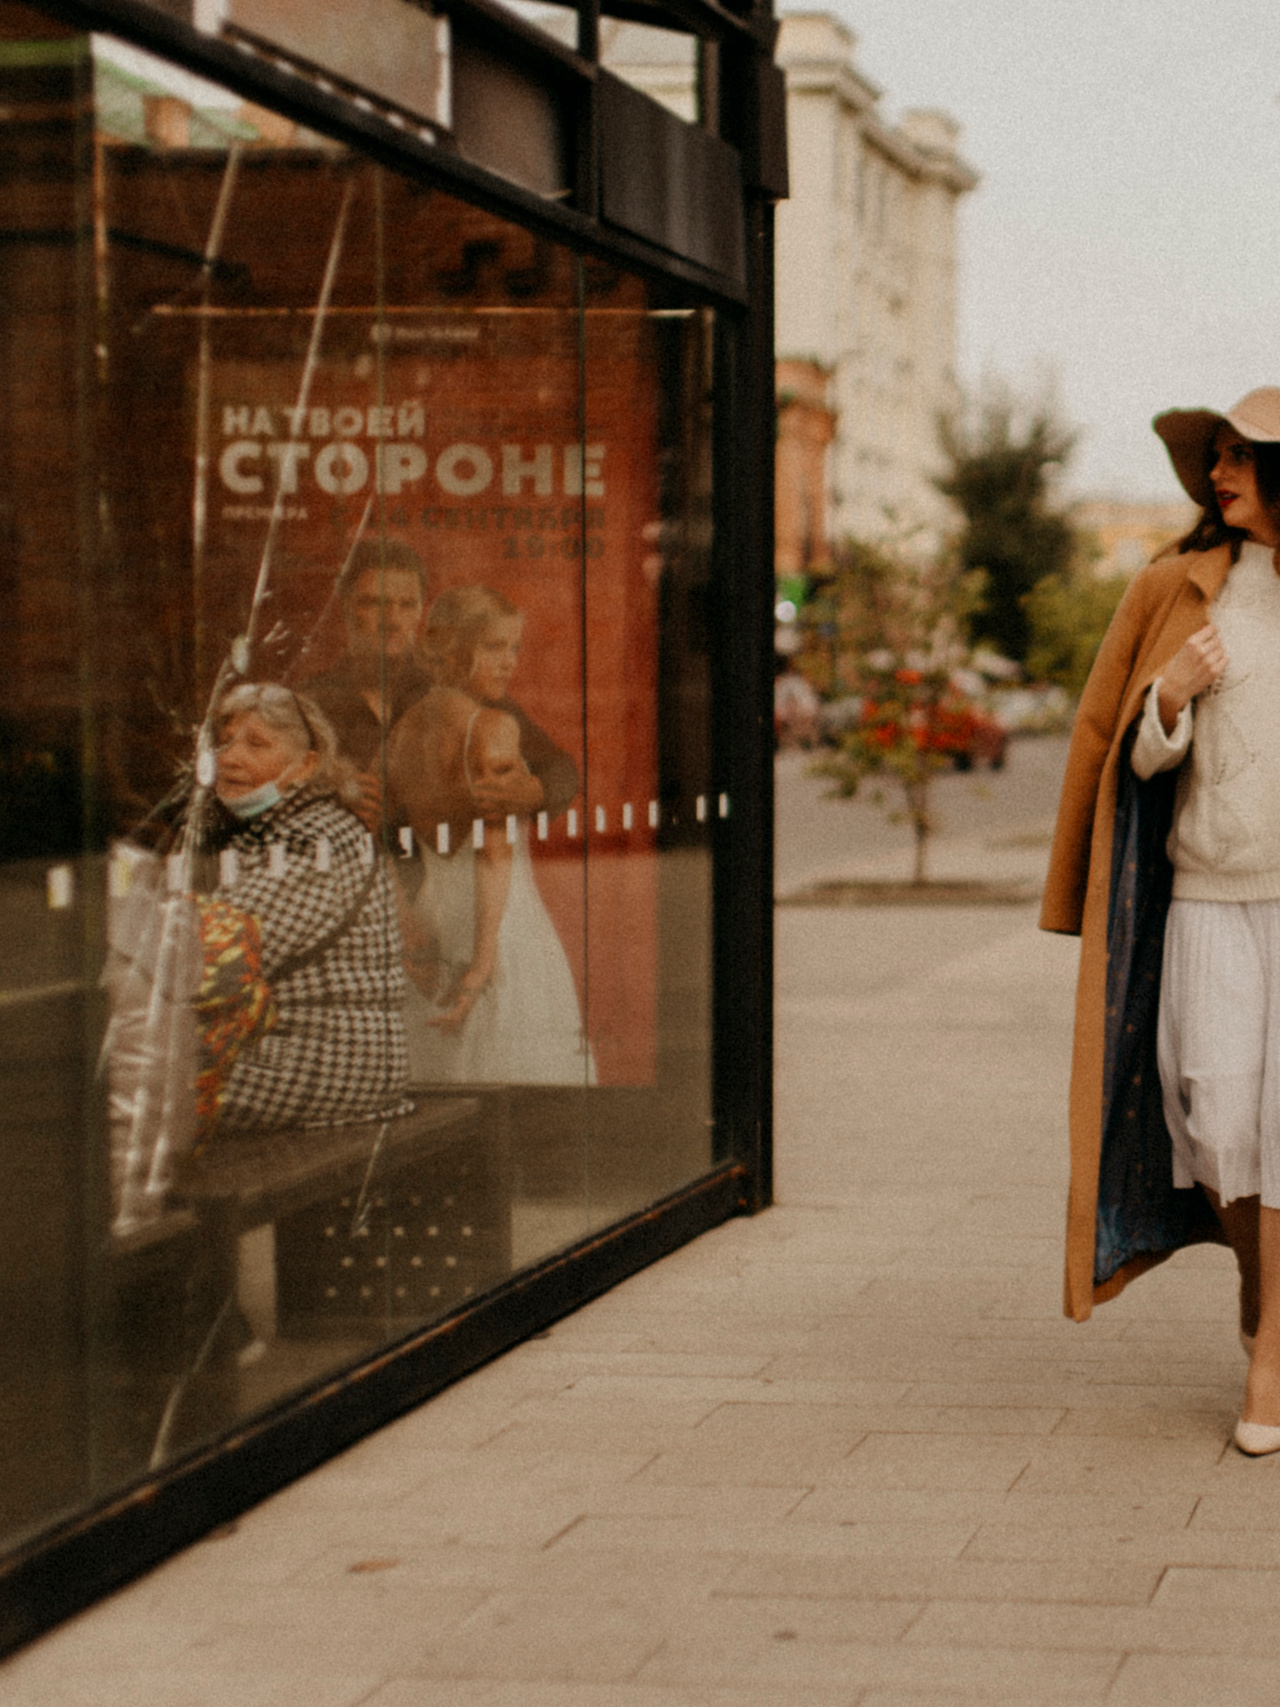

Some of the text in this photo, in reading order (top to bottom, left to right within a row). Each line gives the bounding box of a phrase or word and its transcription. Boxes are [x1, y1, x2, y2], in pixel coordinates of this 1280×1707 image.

[222, 405, 276, 436] НА
[282, 399, 426, 437] ТВОЕЙ
[219, 441, 606, 496] СТОРОНЕ
